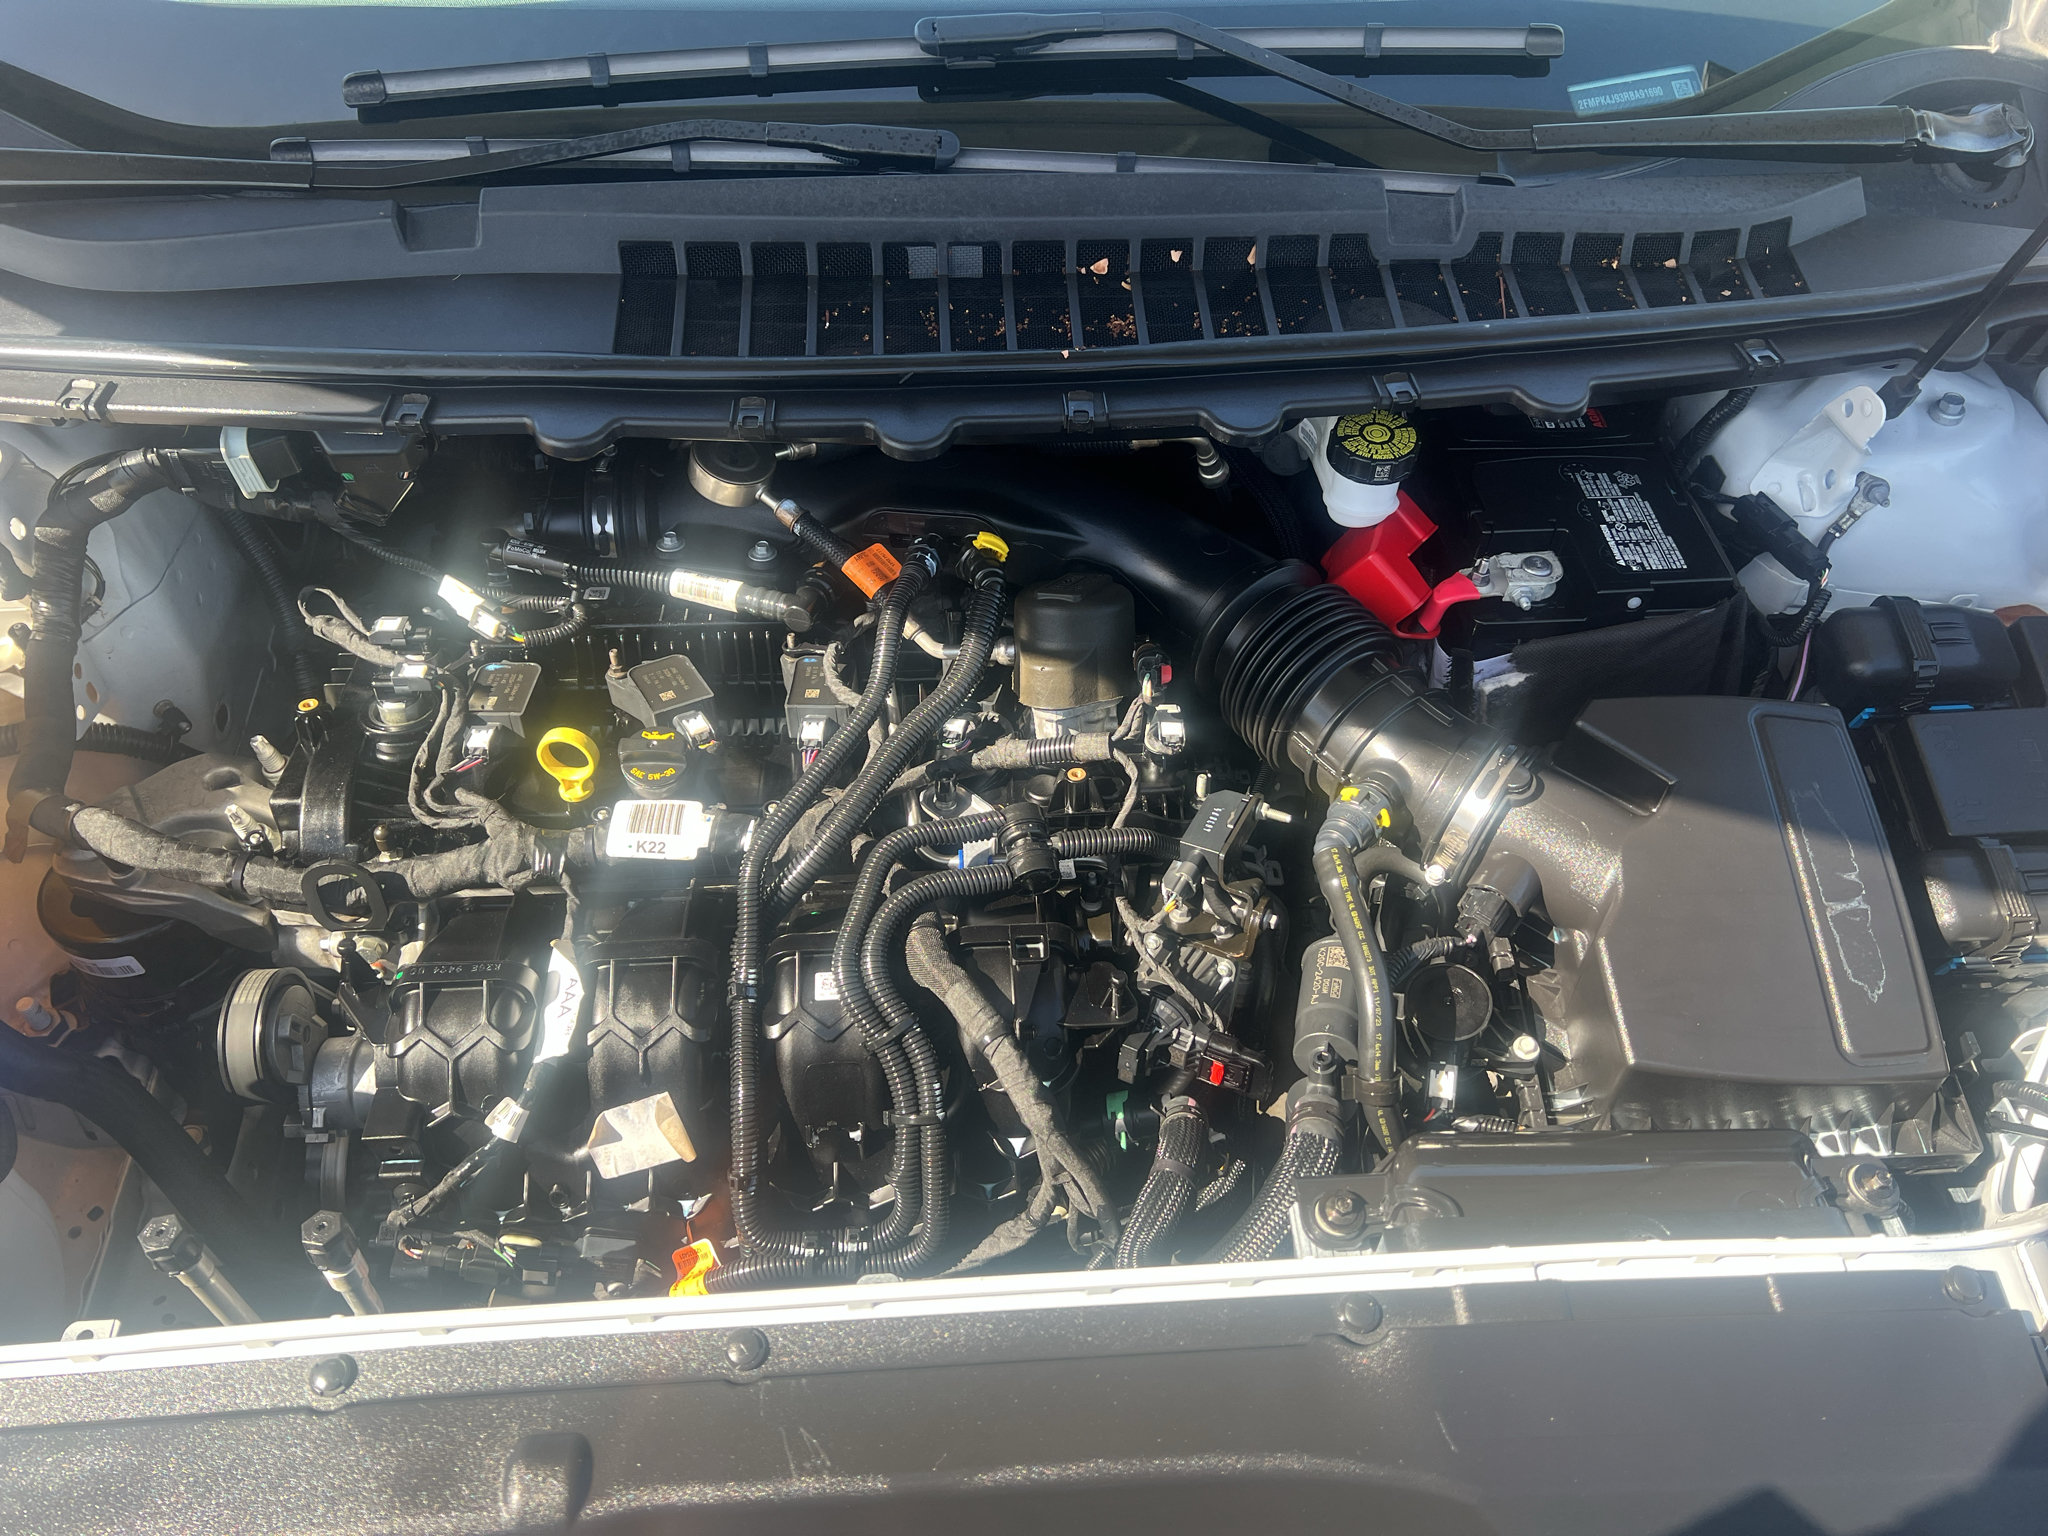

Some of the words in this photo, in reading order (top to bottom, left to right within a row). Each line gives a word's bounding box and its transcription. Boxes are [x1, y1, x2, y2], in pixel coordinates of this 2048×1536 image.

[1577, 86, 1664, 110] 2FMPK4J93RBA91690
[630, 767, 646, 780] SAE
[648, 767, 676, 781] 5W-30
[636, 841, 666, 854] K22
[1345, 890, 1354, 902] TYPE
[1368, 966, 1376, 976] DOT
[1374, 997, 1382, 1027] 11/07/23
[557, 978, 578, 1019] AAA
